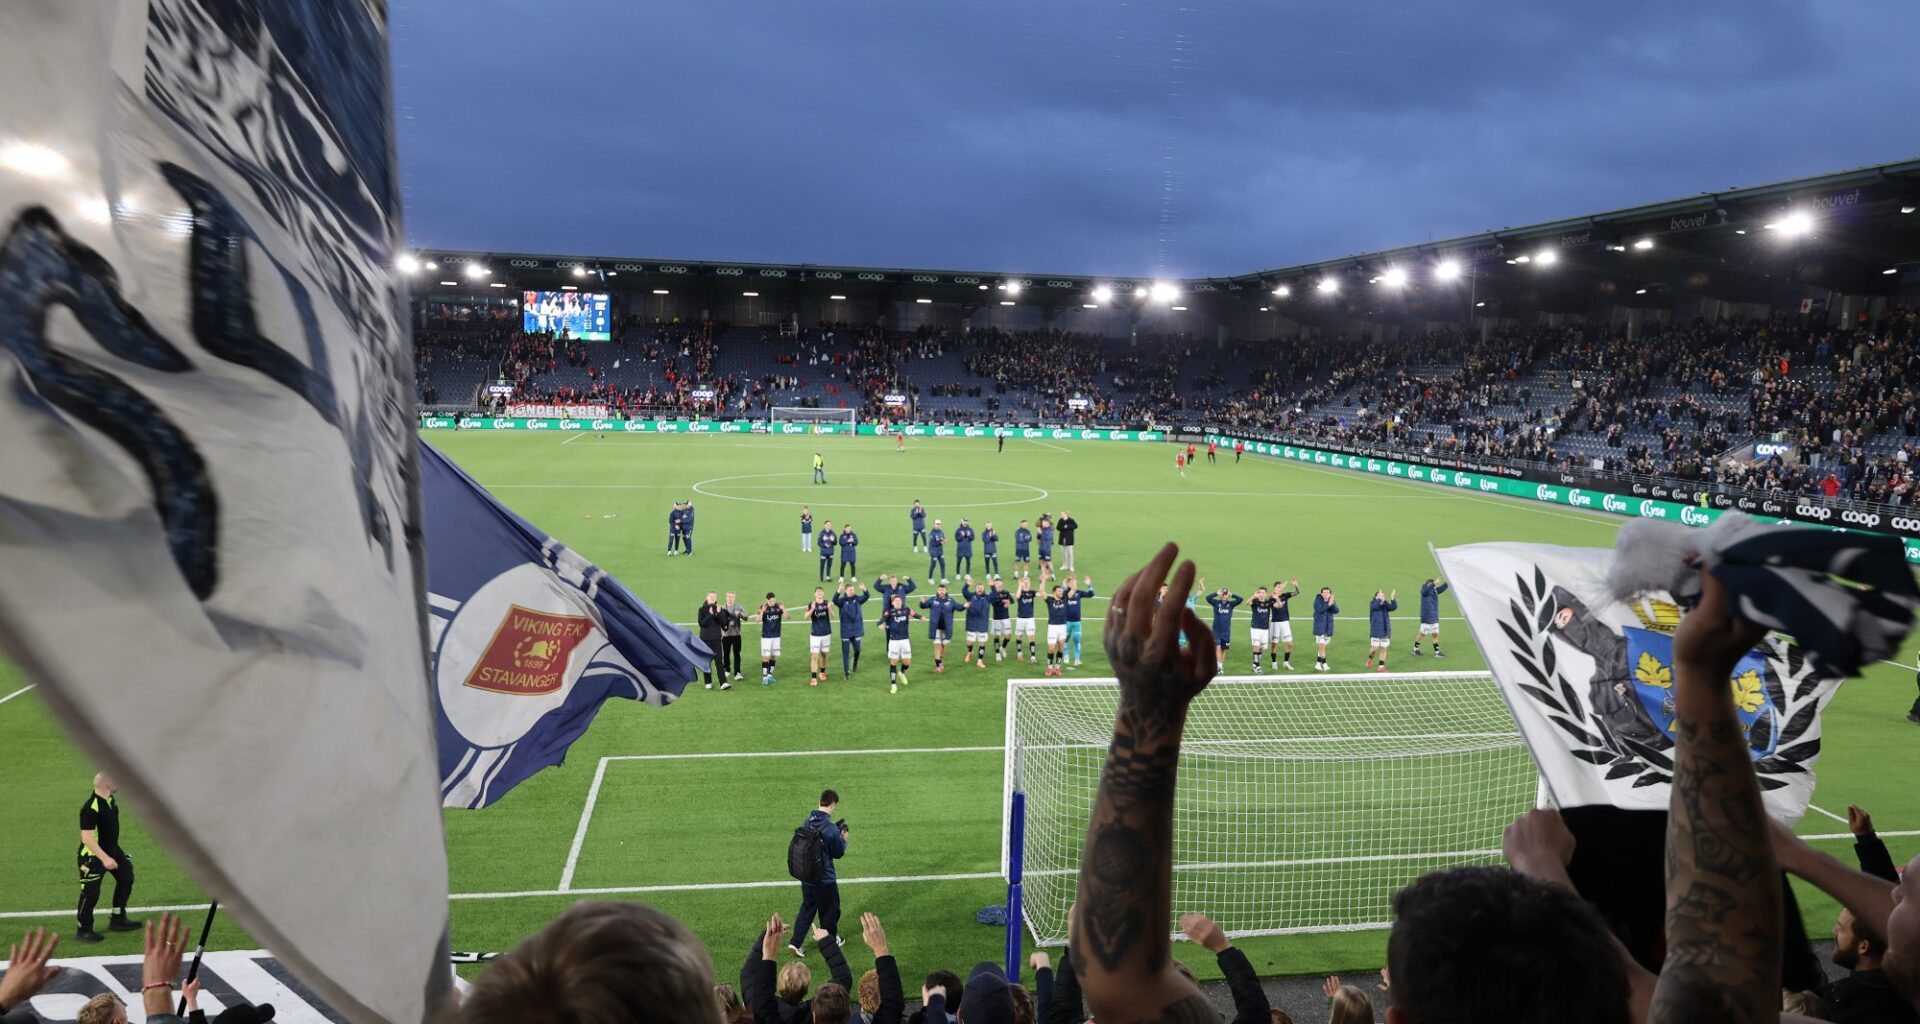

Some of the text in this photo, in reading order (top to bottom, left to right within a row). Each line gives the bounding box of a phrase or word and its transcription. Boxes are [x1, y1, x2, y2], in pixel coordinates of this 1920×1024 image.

[1812, 189, 1860, 208] bouvet
[1671, 213, 1708, 230] bouvet
[510, 259, 539, 269] coop
[615, 264, 642, 272] coop
[660, 266, 687, 274] coop
[716, 268, 743, 276] coop
[760, 269, 787, 278] coop
[816, 271, 842, 280] coop
[858, 273, 884, 281] coop
[912, 274, 938, 283] coop
[954, 276, 980, 285] coop
[1048, 280, 1072, 288] coop
[490, 386, 512, 394] coop
[1410, 467, 1422, 478] Lyse
[1433, 470, 1446, 482] Lyse
[1561, 472, 1574, 483] Lyse
[1457, 474, 1471, 486] Lyse
[1483, 480, 1498, 490] Lyse
[1540, 486, 1557, 500] Lyse
[1635, 485, 1647, 494] Lyse
[1654, 488, 1667, 496] Lyse
[1674, 490, 1688, 499] Lyse
[1572, 491, 1590, 505] Lyse
[1718, 496, 1732, 506] Lyse
[1606, 496, 1626, 511] Lyse
[1741, 499, 1756, 509] Lyse
[1766, 503, 1780, 512] Lyse
[1644, 502, 1665, 517] Lyse
[1796, 505, 1831, 520] coop
[1685, 508, 1709, 524] Lyse
[1841, 511, 1880, 527] coop
[1891, 517, 1920, 532] coo
[514, 615, 582, 636] VIKING F.K.
[479, 667, 558, 688] STAVANGER
